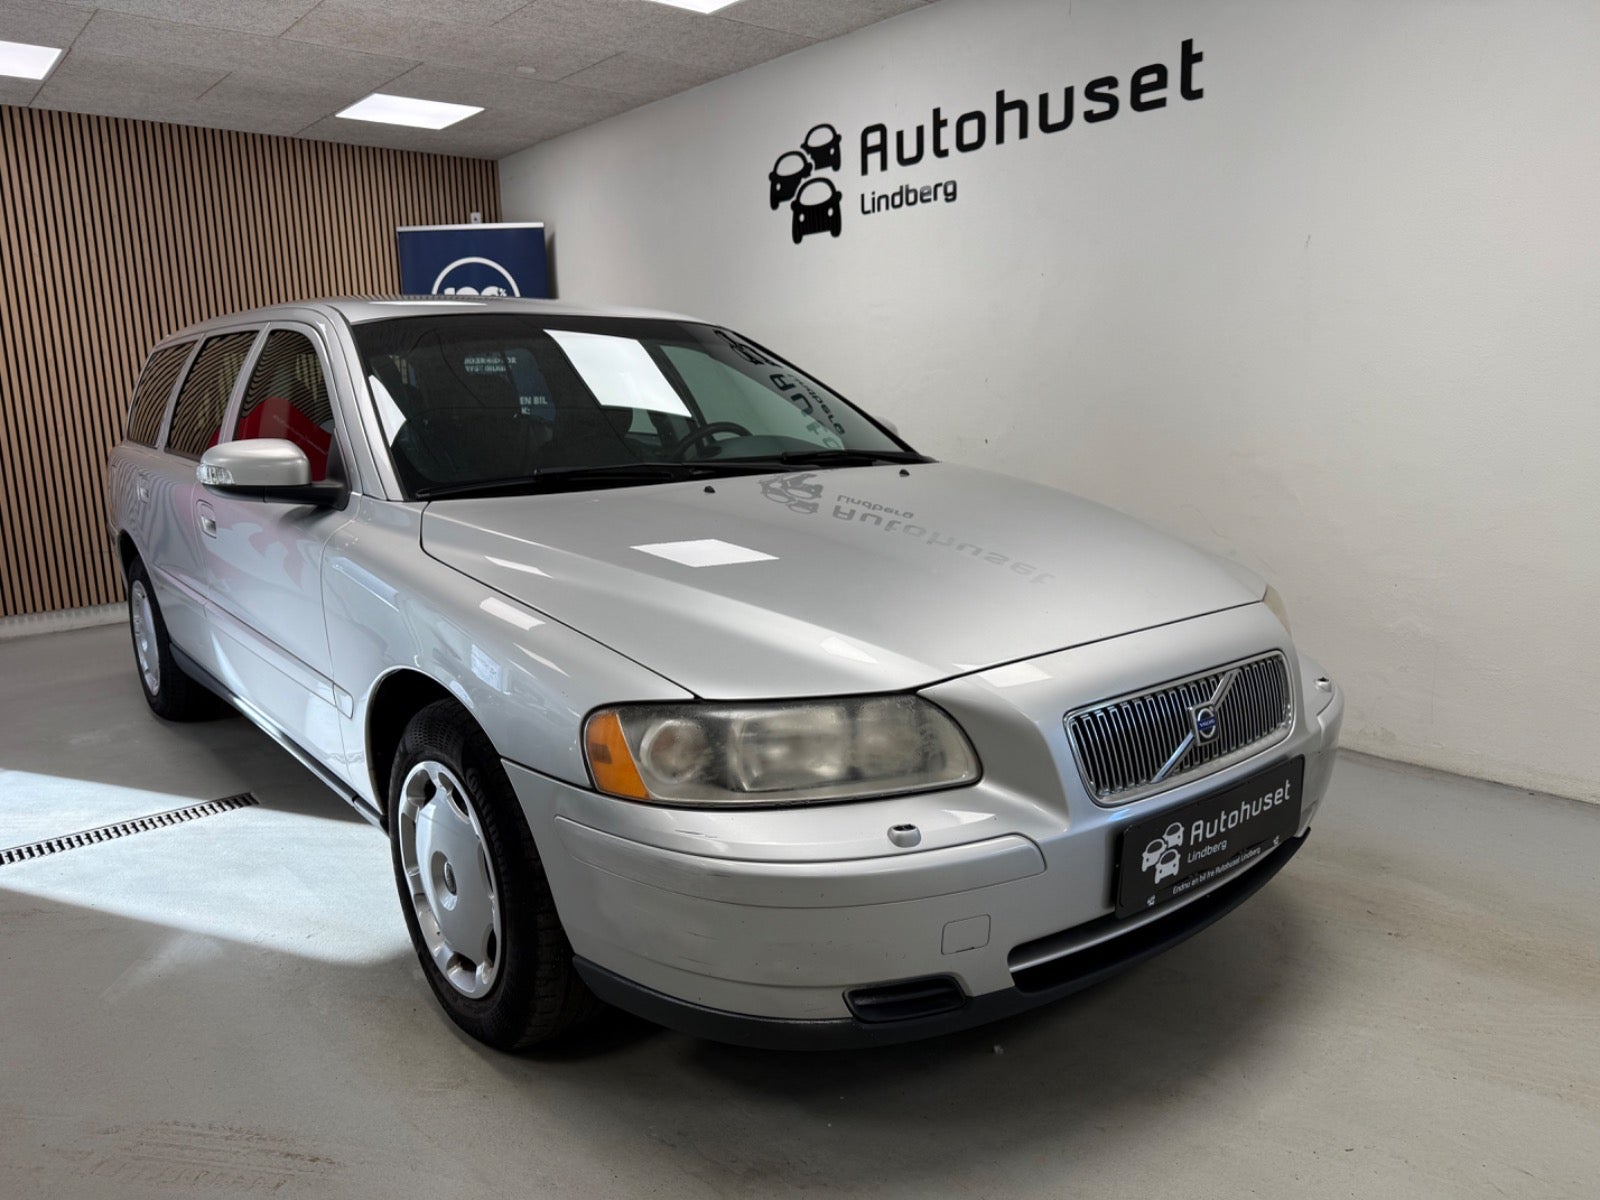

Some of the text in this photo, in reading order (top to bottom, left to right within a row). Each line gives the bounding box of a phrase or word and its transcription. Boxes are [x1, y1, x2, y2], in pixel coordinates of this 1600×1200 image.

[860, 38, 1204, 176] Autohuset
[860, 179, 958, 215] Lindberg
[1190, 779, 1291, 846] Autohuset
[1187, 839, 1228, 864] Lindberg
